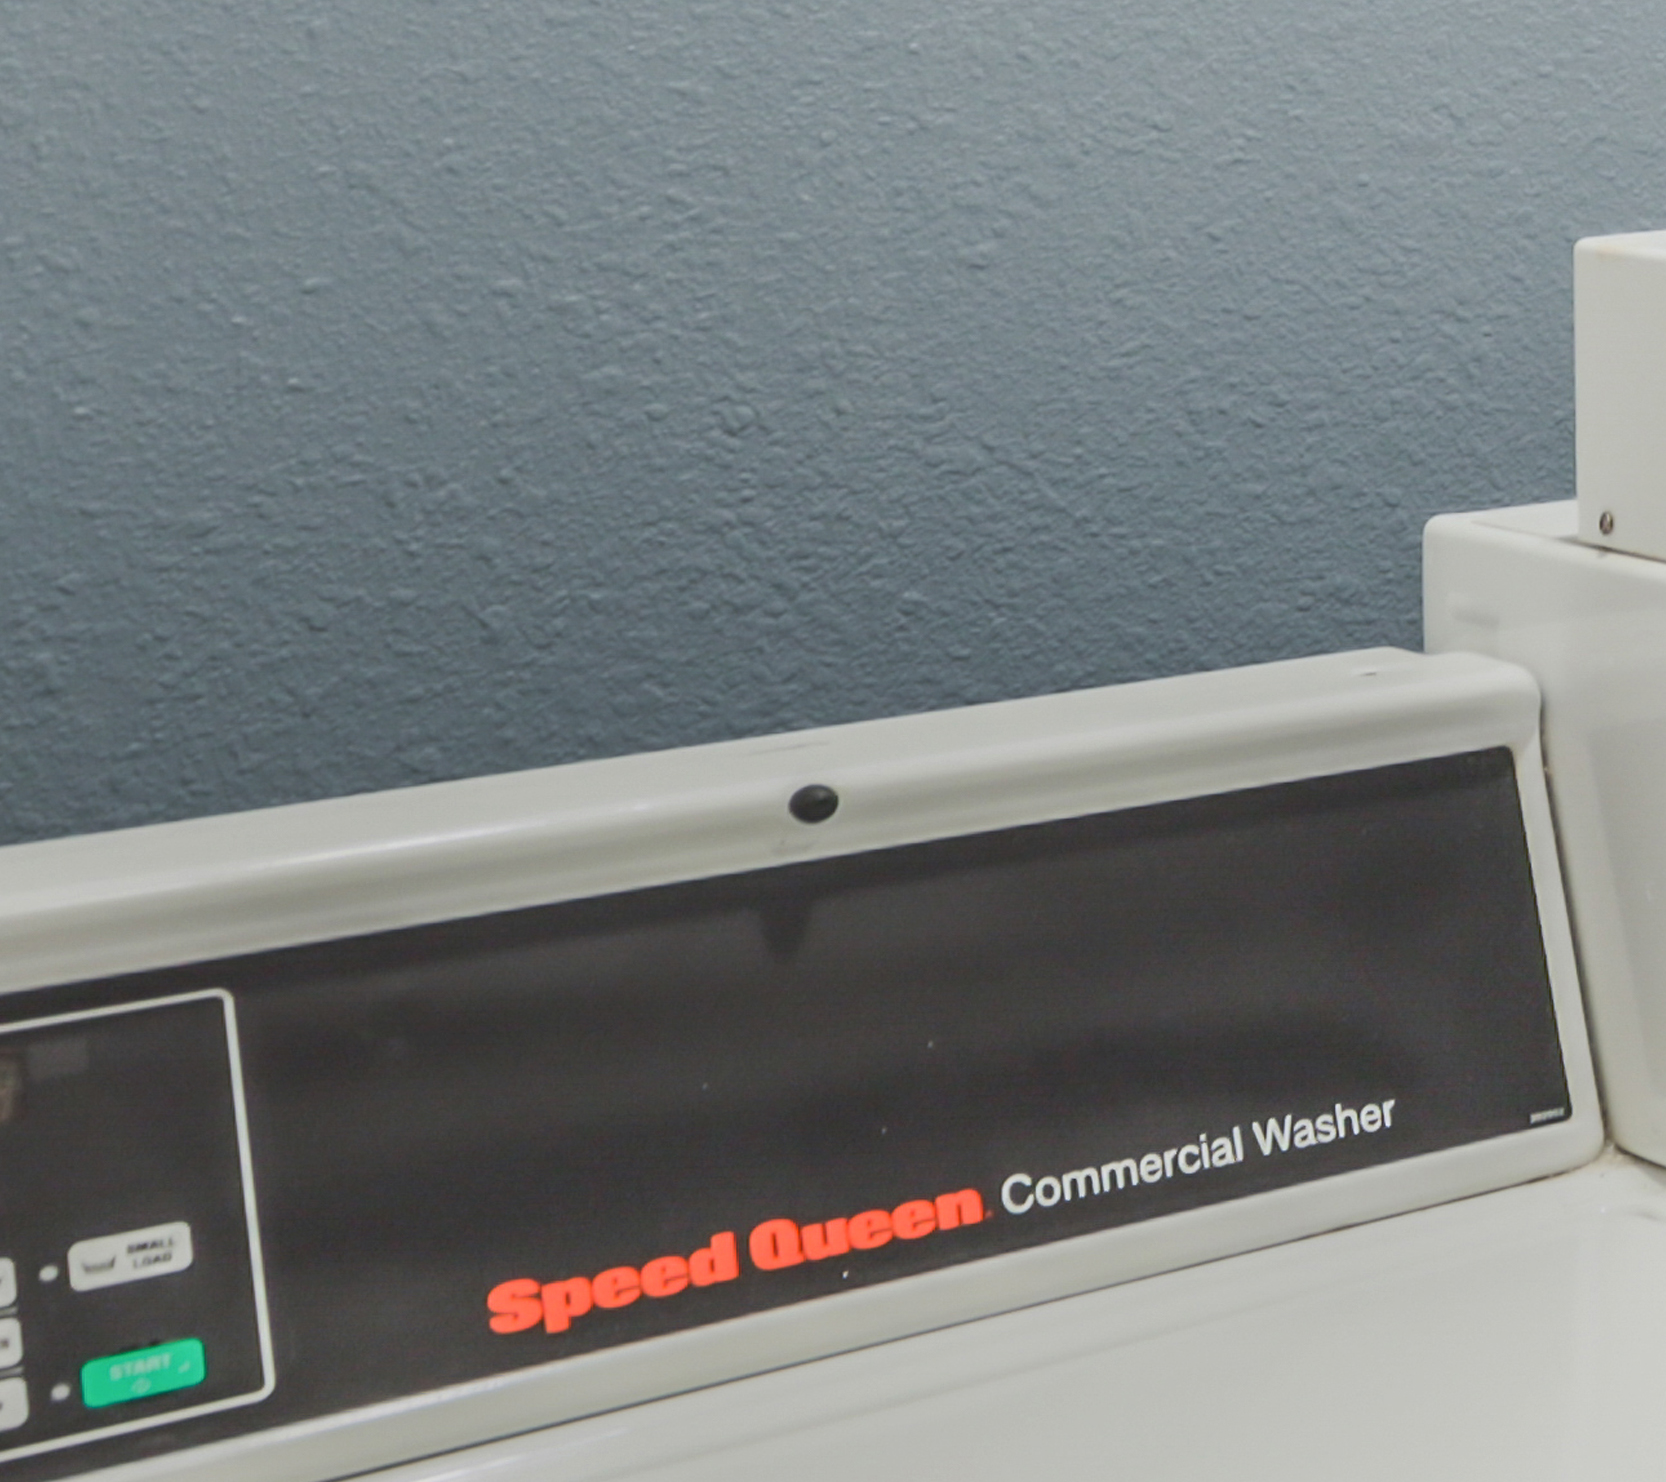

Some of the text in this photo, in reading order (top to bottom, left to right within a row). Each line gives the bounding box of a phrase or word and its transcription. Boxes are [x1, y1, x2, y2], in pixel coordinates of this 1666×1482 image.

[486, 1098, 1396, 1335] Speed Queen Commercial Washer
[126, 1236, 176, 1255] SMALL
[132, 1252, 173, 1269] LOAD
[108, 1351, 173, 1382] START
